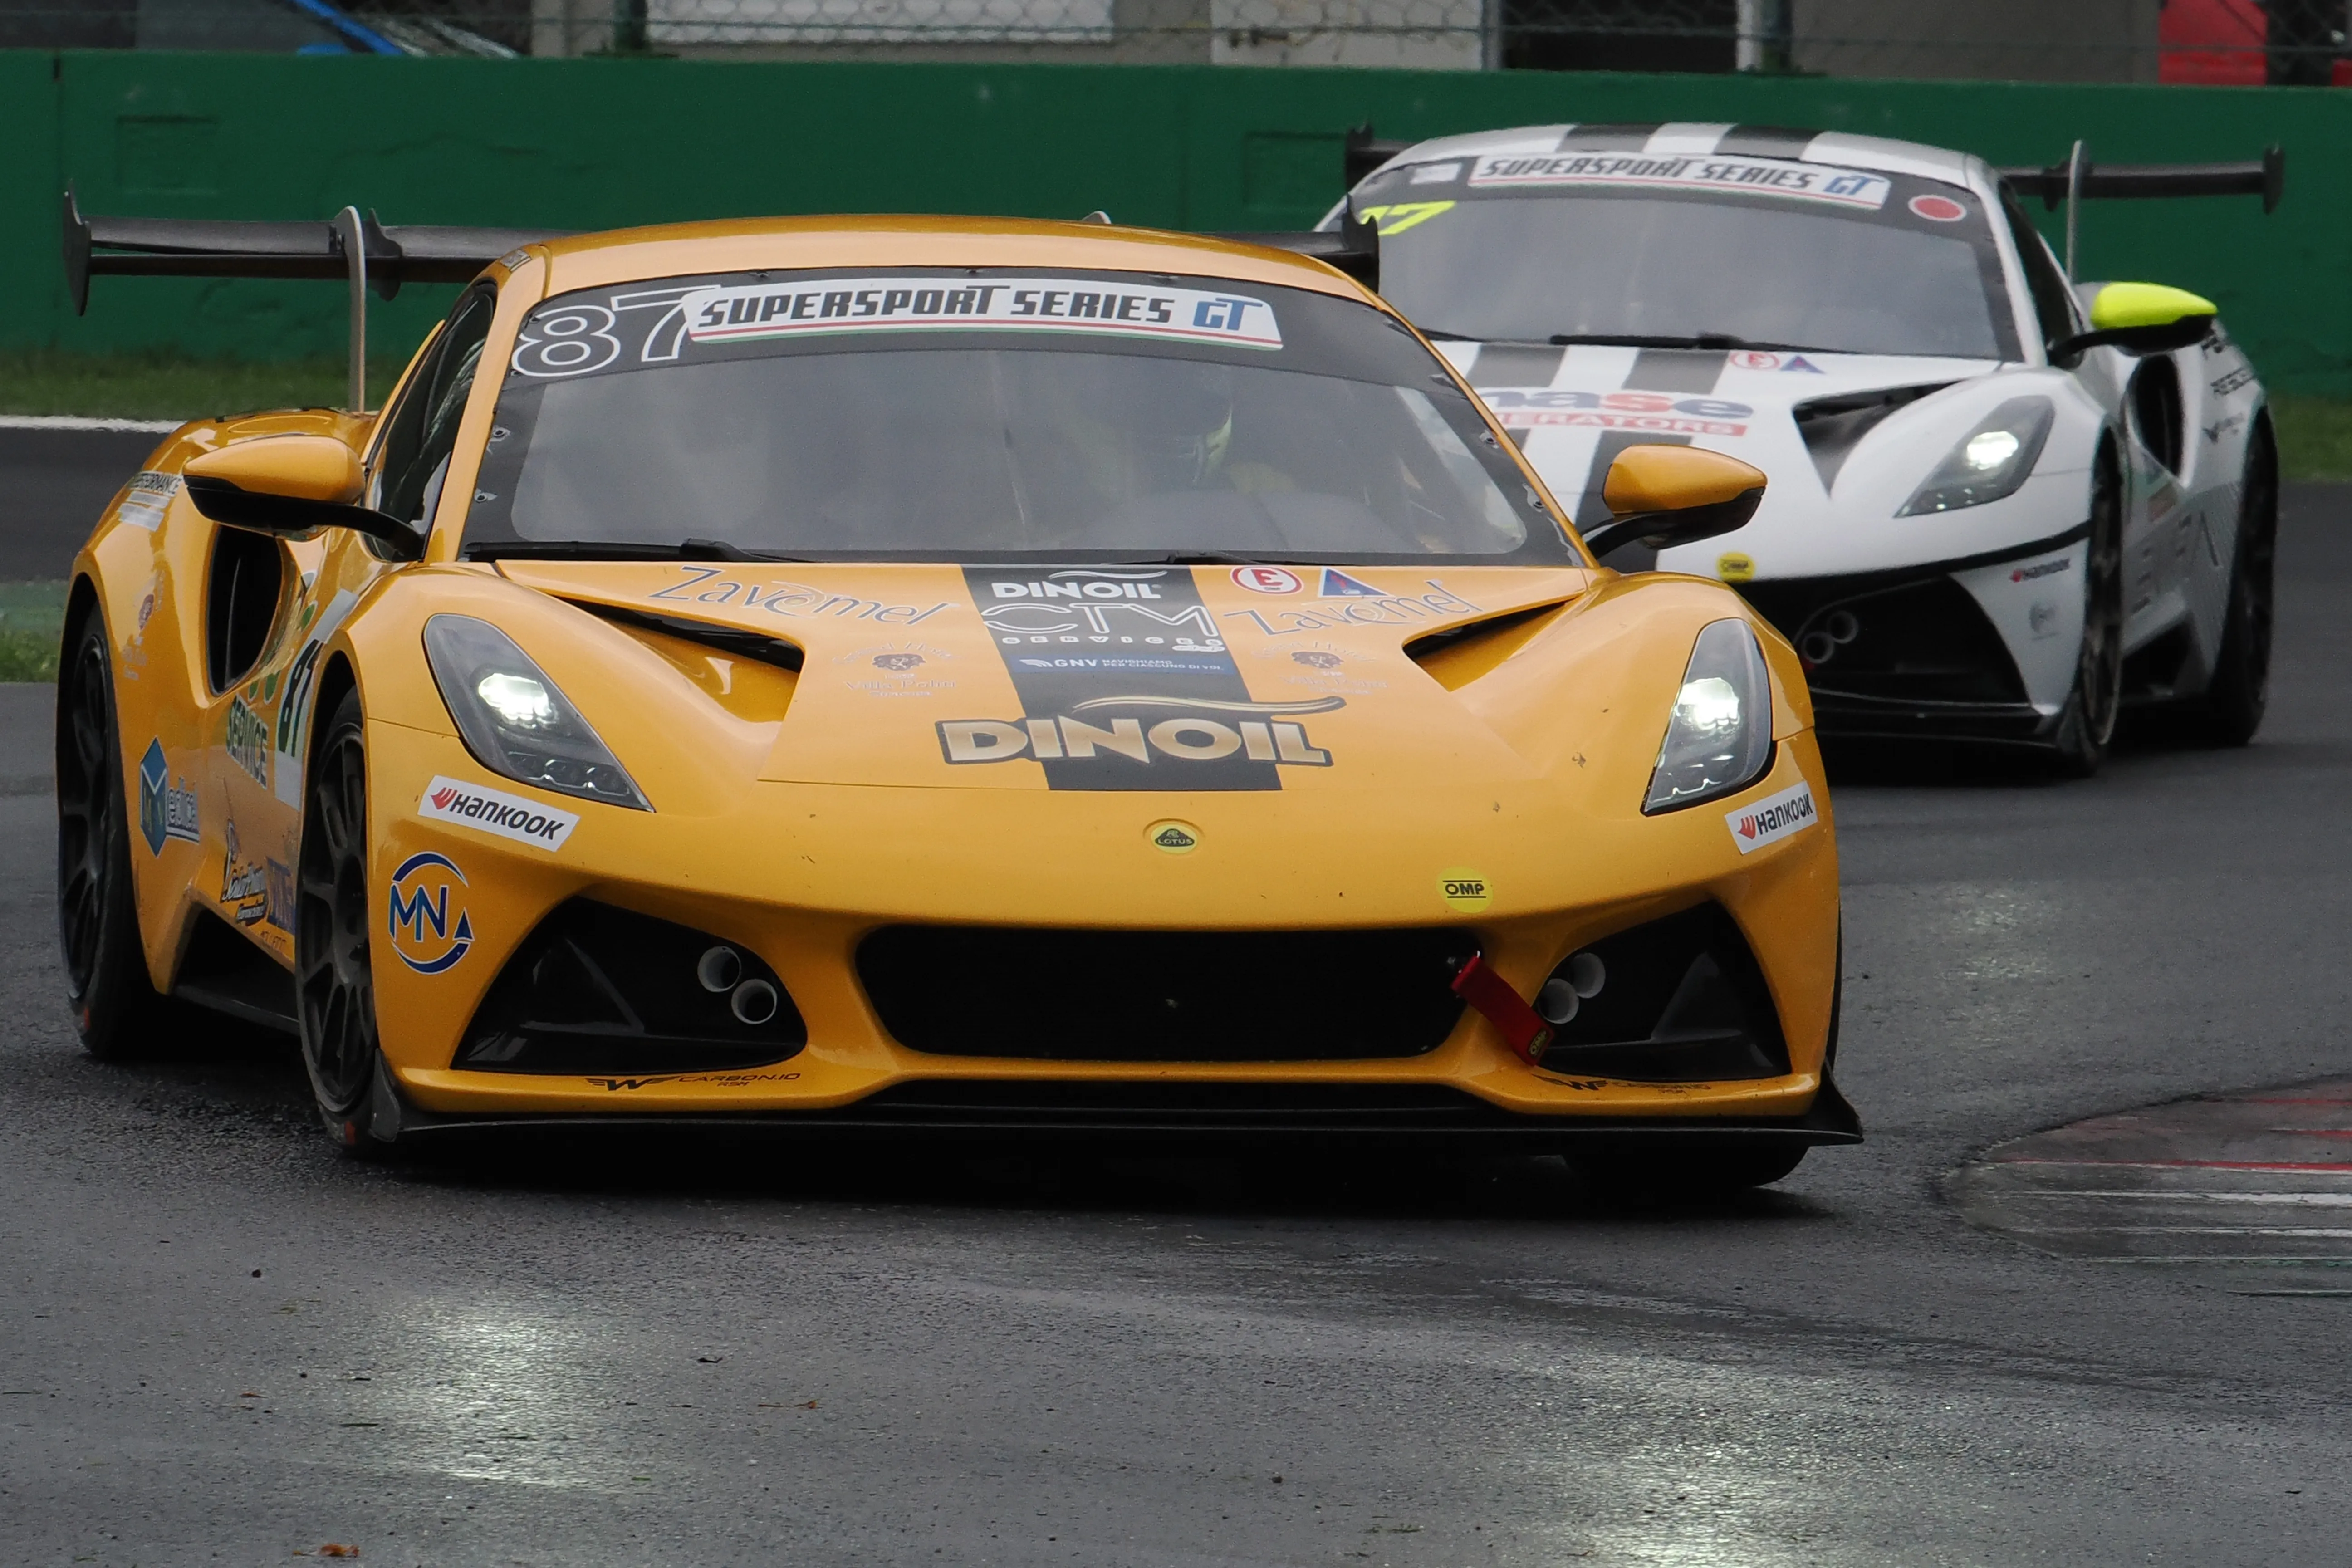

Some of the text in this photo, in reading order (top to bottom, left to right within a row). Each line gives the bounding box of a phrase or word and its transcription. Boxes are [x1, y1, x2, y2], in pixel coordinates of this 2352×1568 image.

[1479, 157, 1880, 196] SUPERSPORT SERIES GT
[697, 285, 1263, 331] SUPERSPORT SERIES GT
[511, 284, 720, 377] 87
[991, 581, 1161, 599] DINOIL
[980, 603, 1219, 637] CTM
[1054, 659, 1098, 667] GNV
[936, 715, 1333, 767] DINOIL
[1445, 883, 1485, 895] OMP
